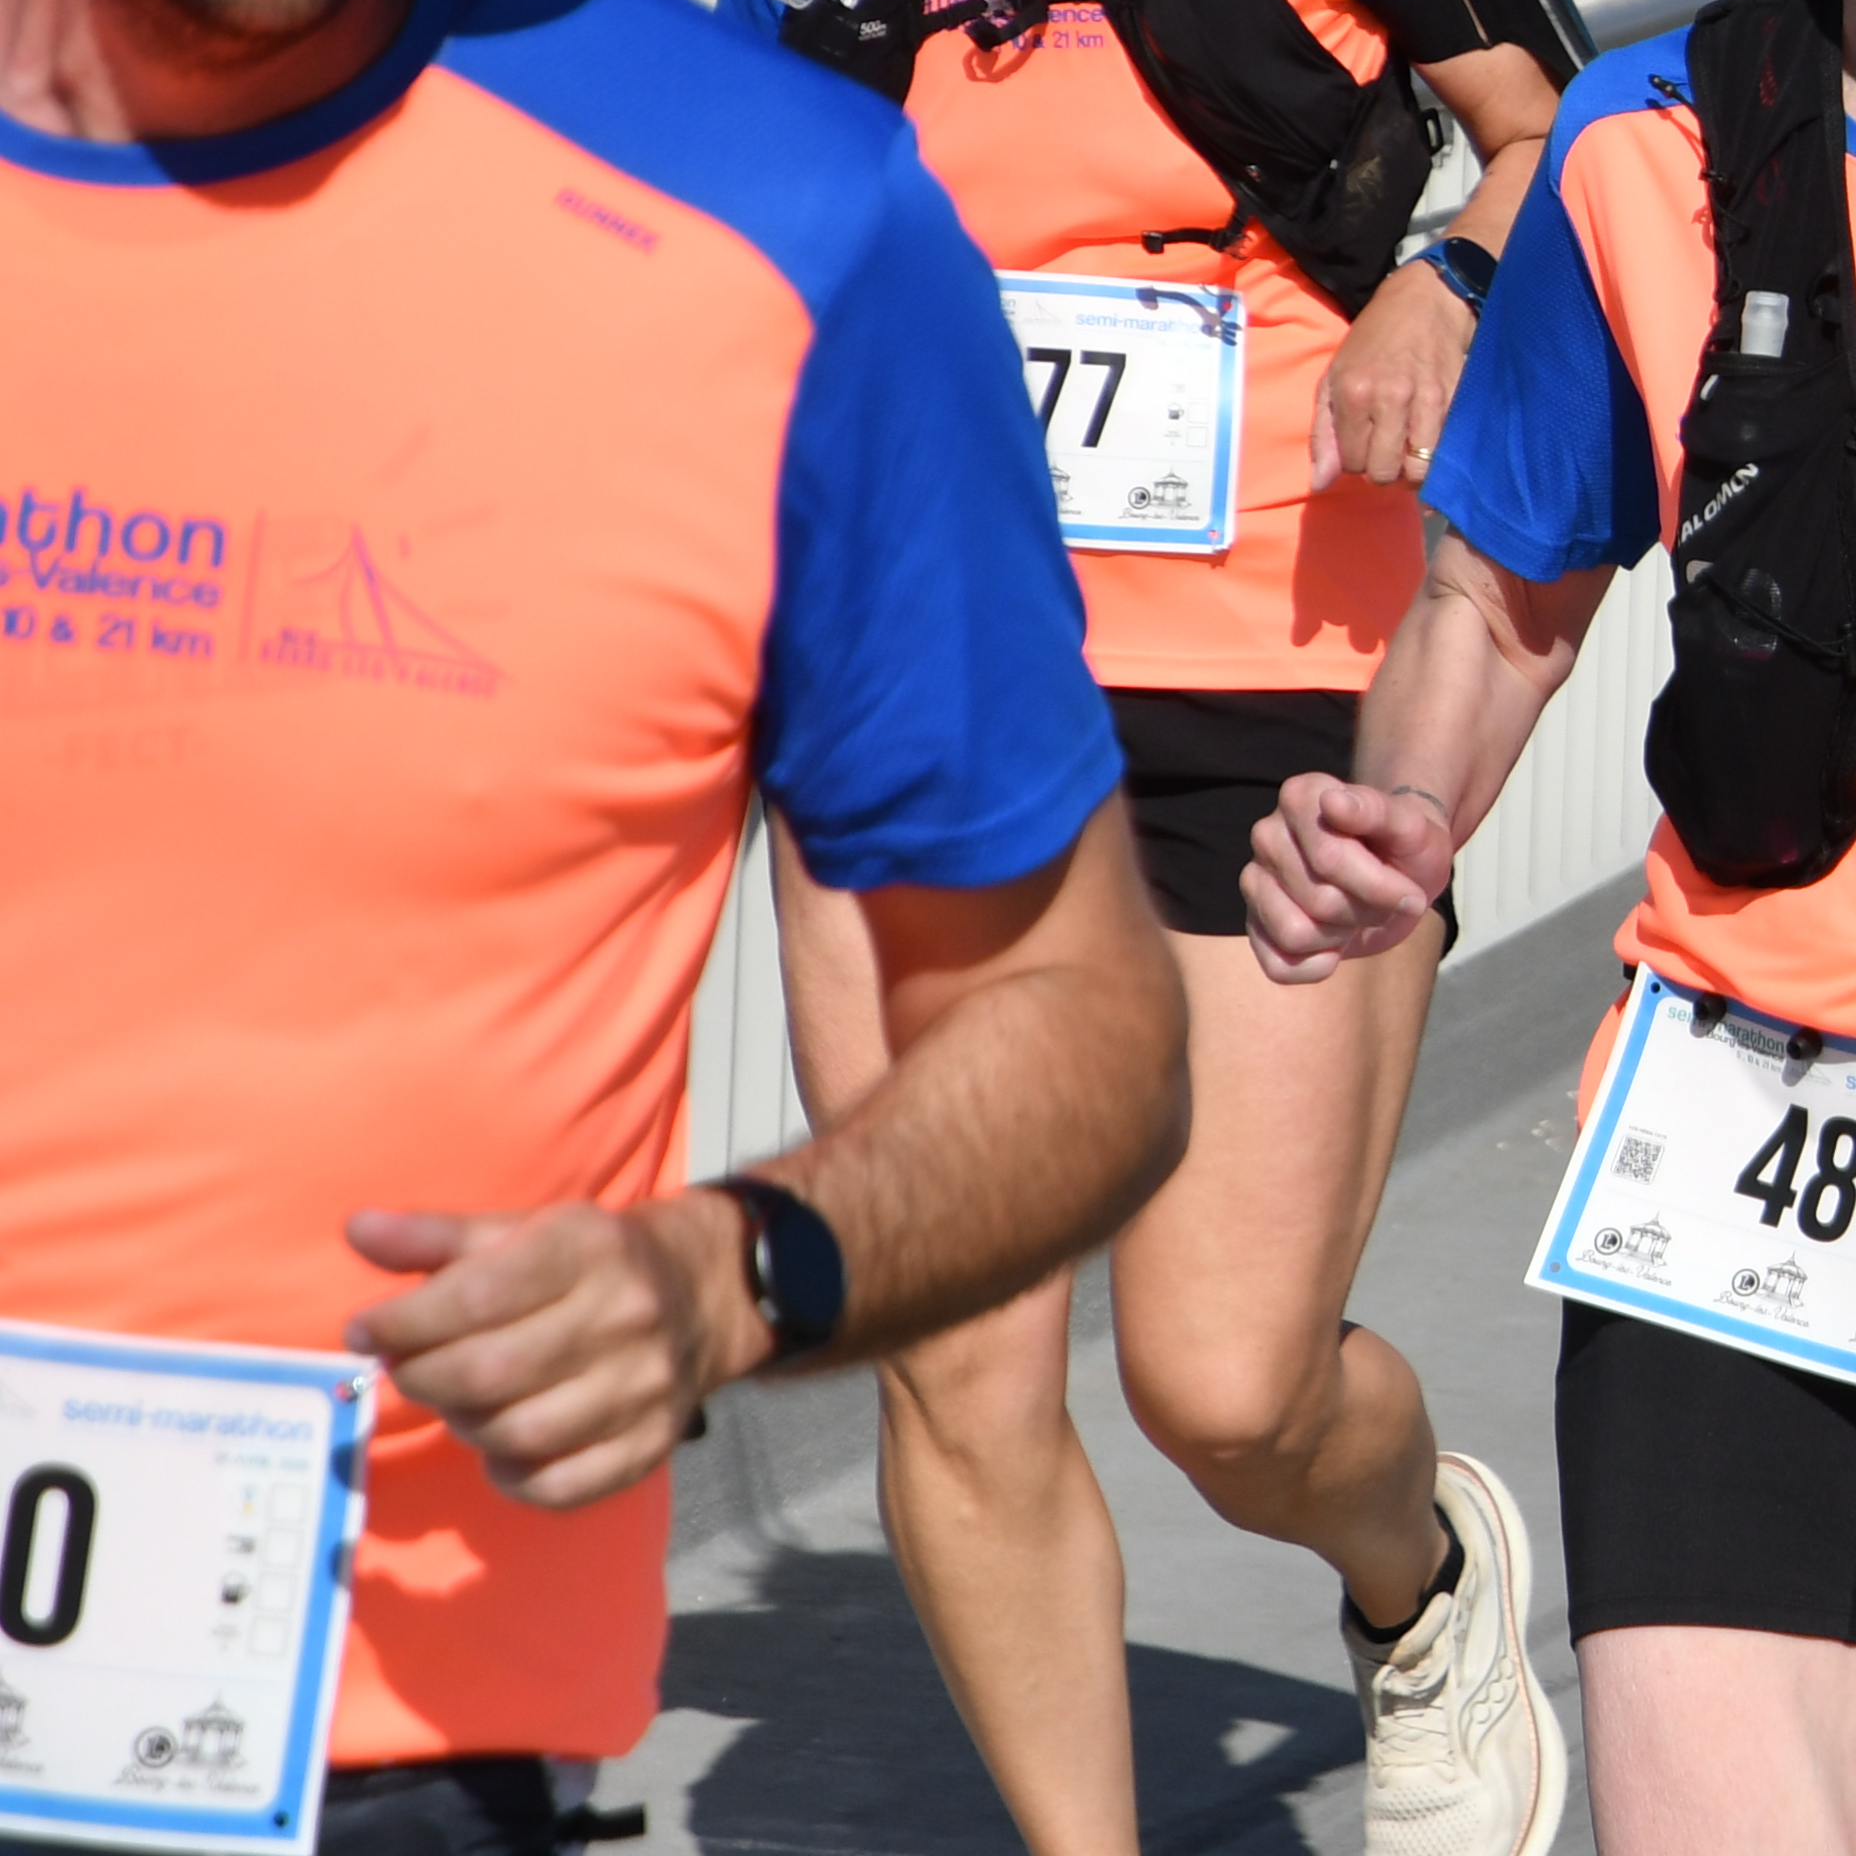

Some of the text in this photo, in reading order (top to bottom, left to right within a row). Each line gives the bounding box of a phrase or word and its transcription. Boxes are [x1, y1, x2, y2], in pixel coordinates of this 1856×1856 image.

[1053, 32, 1070, 49] 21
[1076, 31, 1104, 48] km
[1678, 462, 1759, 547] ALOMON
